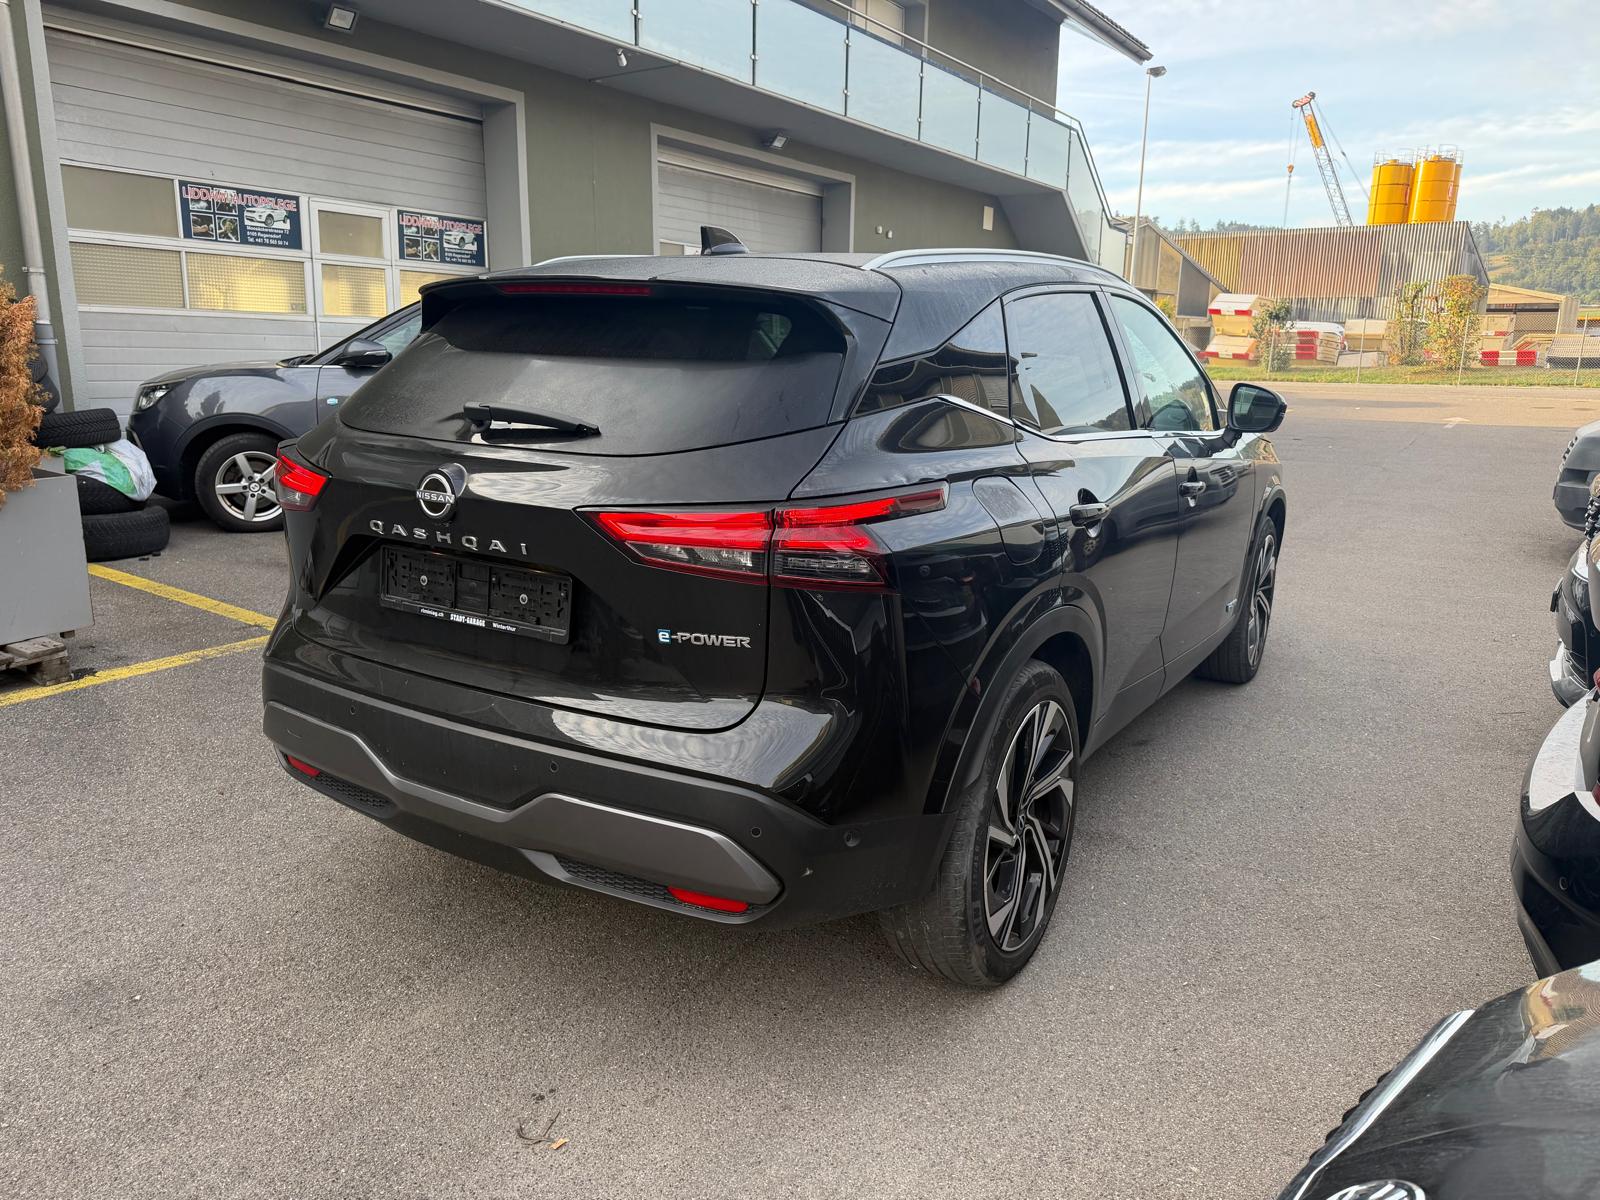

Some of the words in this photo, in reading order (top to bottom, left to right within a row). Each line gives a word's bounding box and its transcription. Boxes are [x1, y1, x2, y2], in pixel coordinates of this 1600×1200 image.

[231, 193, 297, 211] AUTOPFLEGE
[416, 491, 455, 503] NISSAN
[369, 519, 528, 555] QASHQAI
[450, 613, 486, 627] STADT-GARAGE
[492, 622, 516, 632] Winterthur
